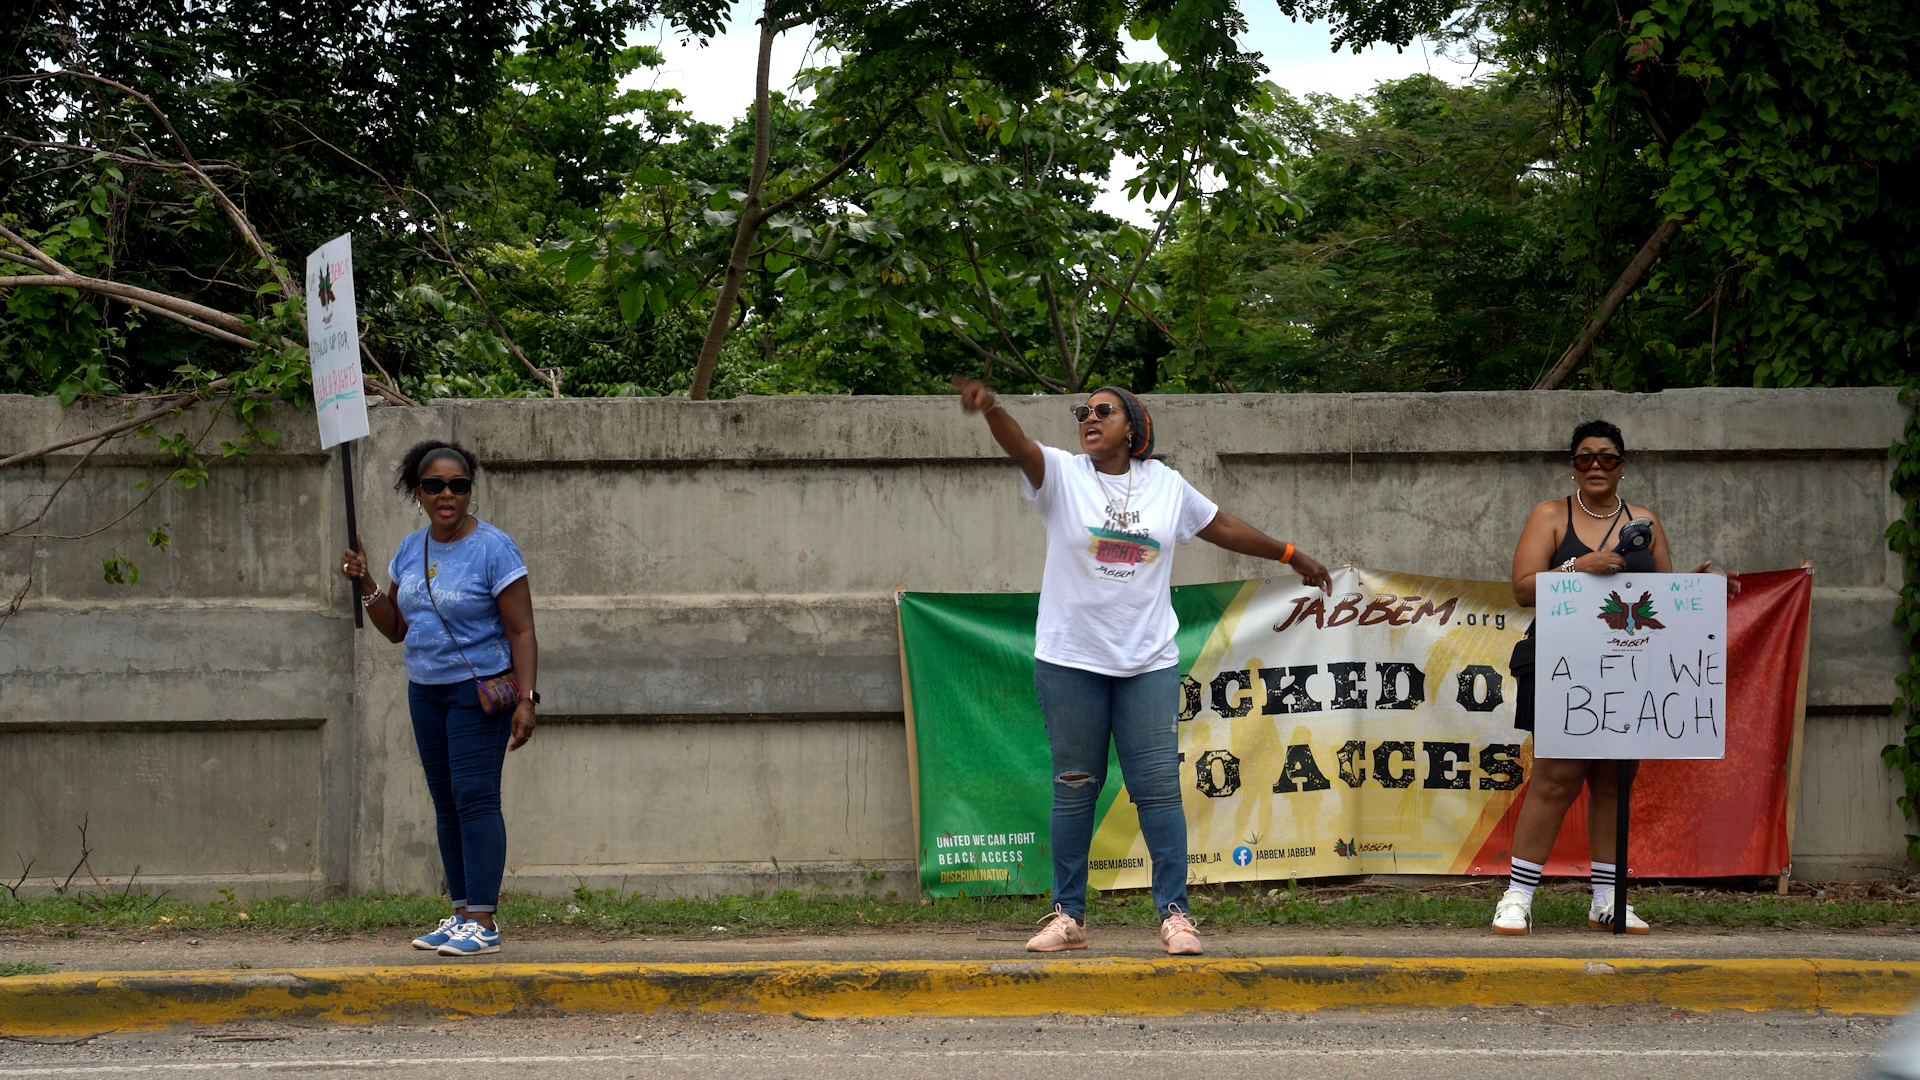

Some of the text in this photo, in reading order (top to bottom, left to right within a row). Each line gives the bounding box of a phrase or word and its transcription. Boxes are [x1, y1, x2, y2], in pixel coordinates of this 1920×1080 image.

[310, 330, 350, 364] STAND UP FOR
[332, 362, 358, 394] RIGHTS
[1098, 541, 1145, 563] RIGHTS
[1095, 565, 1136, 578] JABBEM
[1673, 597, 1704, 611] WE
[1606, 636, 1650, 648] JABBEM
[1551, 649, 1724, 687] A FI WE
[1563, 685, 1718, 740] BEACH
[936, 832, 1036, 848] UNITED WE CAN FIGHT
[938, 850, 1024, 865] BEACH ACCESS
[1256, 846, 1317, 860] JABBEM JABBEM
[940, 868, 1011, 883] DISCRIMINATION
